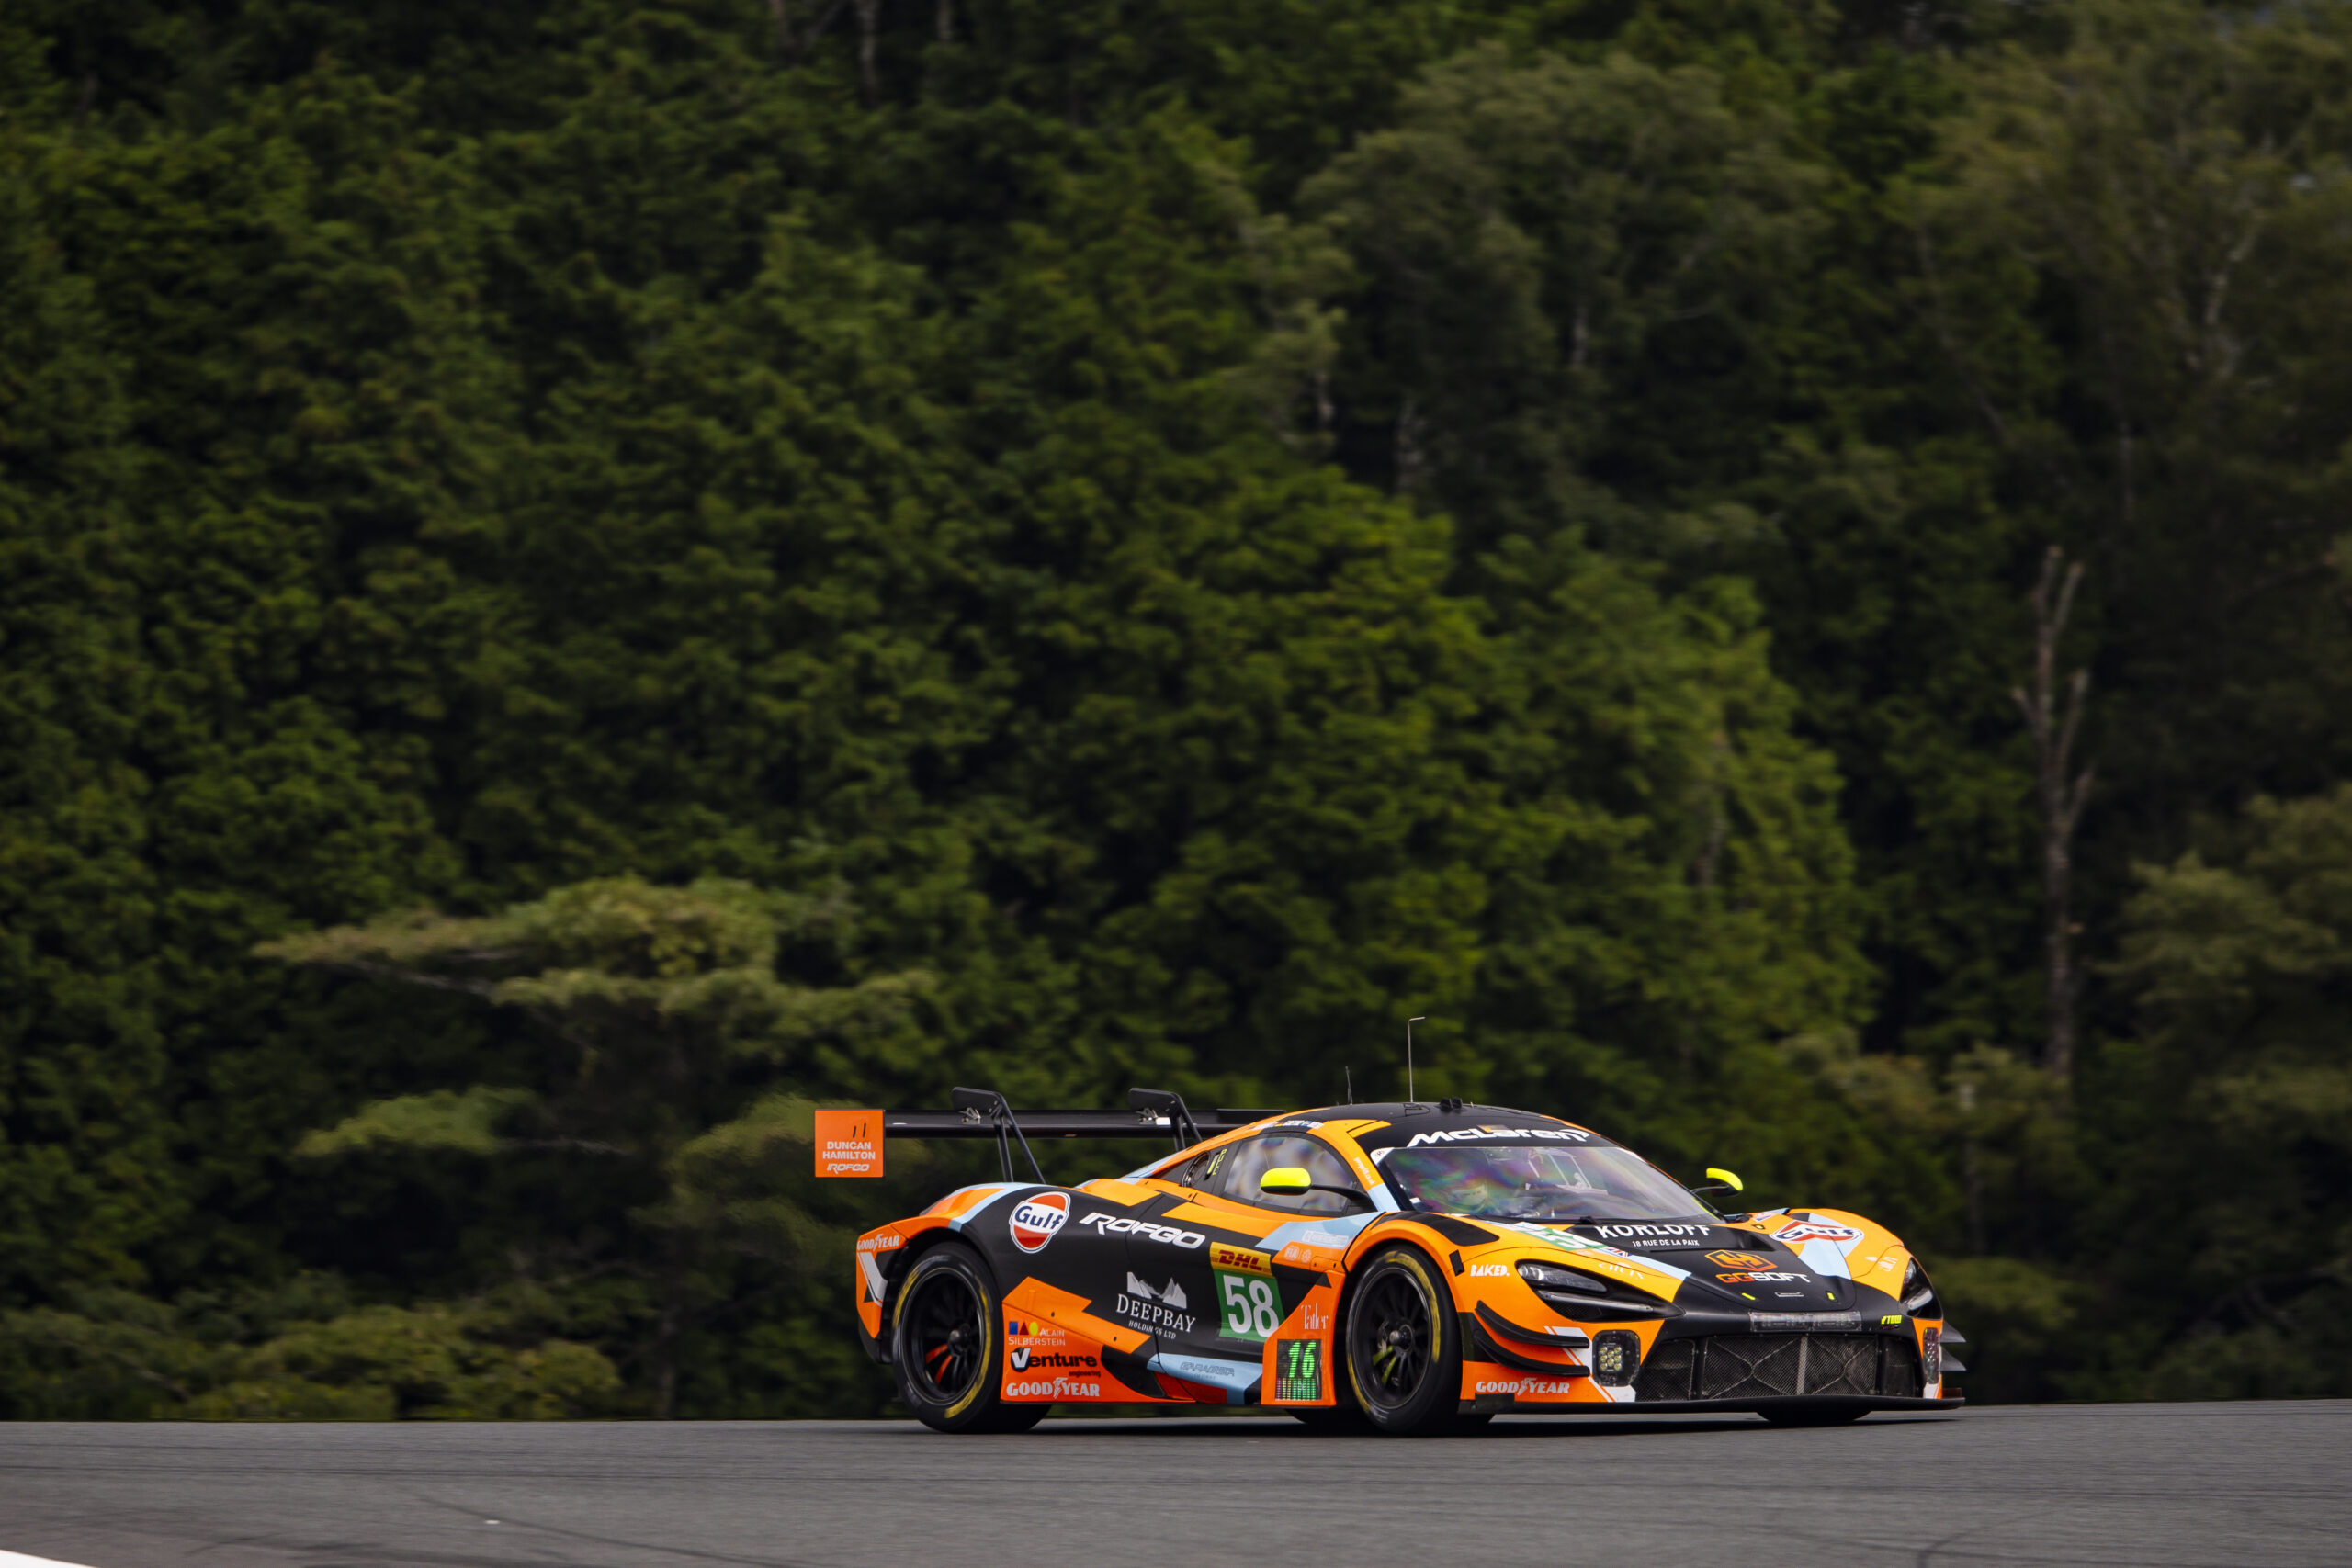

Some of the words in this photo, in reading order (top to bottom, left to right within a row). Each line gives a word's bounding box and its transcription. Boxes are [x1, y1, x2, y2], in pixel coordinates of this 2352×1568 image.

[827, 1141, 872, 1150] DUNCAN
[1407, 1125, 1589, 1148] McLaren
[822, 1151, 876, 1160] HAMILTON
[1014, 1205, 1064, 1231] Gulf
[1079, 1212, 1206, 1249] ROFGO
[1594, 1224, 1710, 1239] KORLOFF
[1218, 1249, 1262, 1271] DHL
[1715, 1272, 1811, 1283] GGSOFT
[1115, 1293, 1196, 1333] DEEPBAY
[1223, 1274, 1280, 1338] 58
[1008, 1336, 1066, 1346] SILBERSTEIN
[1039, 1328, 1065, 1337] ALAIN
[1163, 1329, 1177, 1340] LTD
[1011, 1348, 1098, 1369] Venture
[1288, 1341, 1317, 1379] 16
[1006, 1379, 1101, 1398] GOODYEAR
[1476, 1379, 1570, 1395] GOODYEAR
